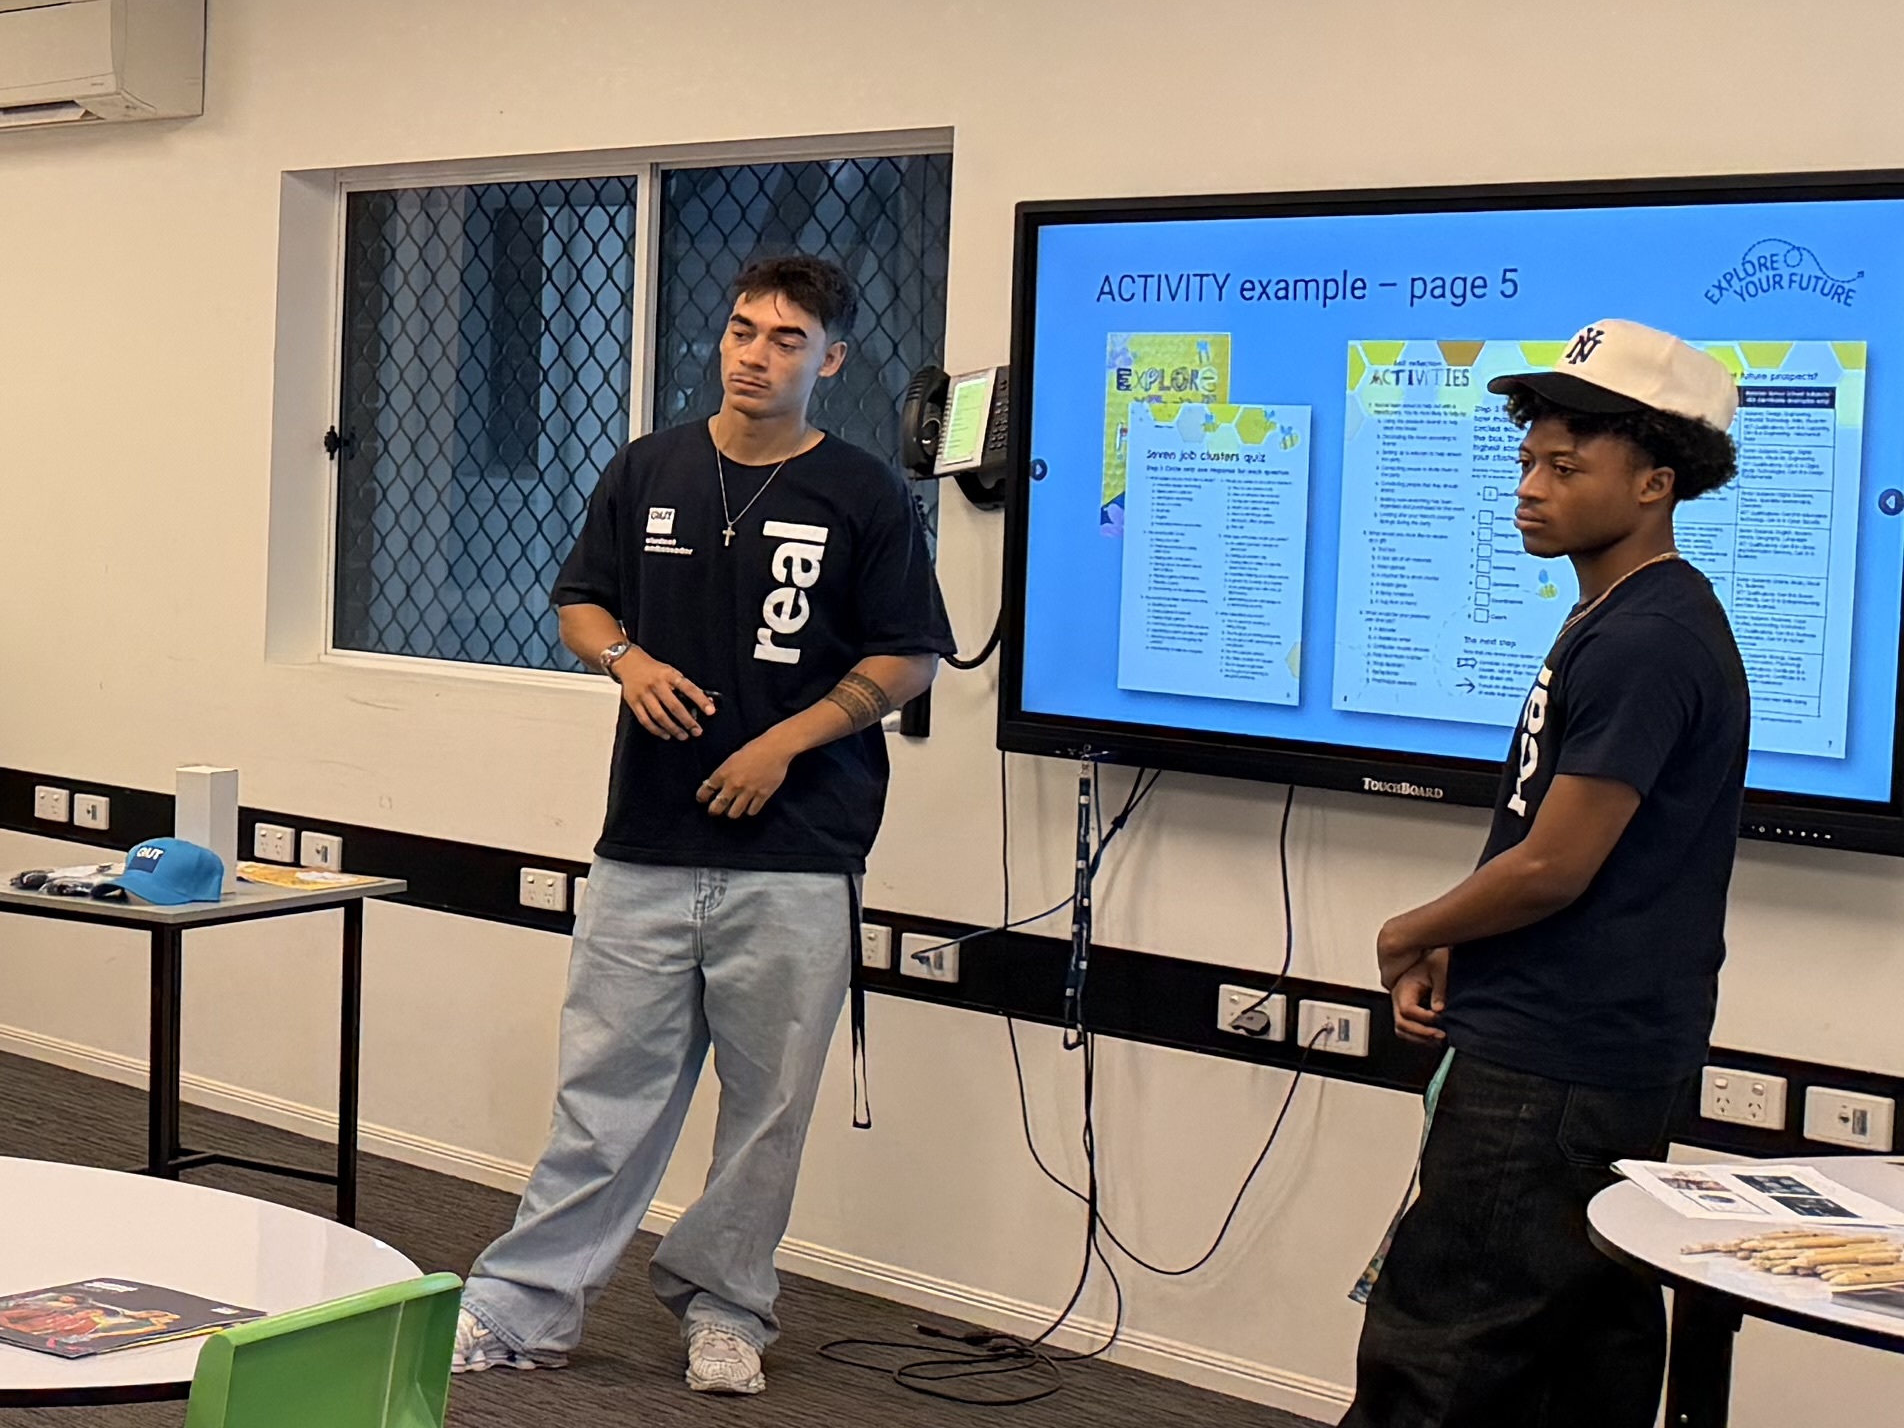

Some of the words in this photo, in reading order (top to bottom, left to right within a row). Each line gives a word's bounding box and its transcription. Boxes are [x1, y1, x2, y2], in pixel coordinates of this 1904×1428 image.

[1096, 272, 1231, 303] ACTIVITY
[1238, 270, 1367, 308] example
[1409, 271, 1489, 307] page
[1499, 267, 1519, 299] 5
[1704, 253, 1780, 305] EXPLORE
[1733, 273, 1784, 302] YOUR
[1788, 272, 1857, 307] FUTURE
[1116, 367, 1218, 393] EXPLORE
[1369, 368, 1470, 387] ACTIVITIES
[754, 521, 829, 664] real
[137, 847, 164, 860] QUT
